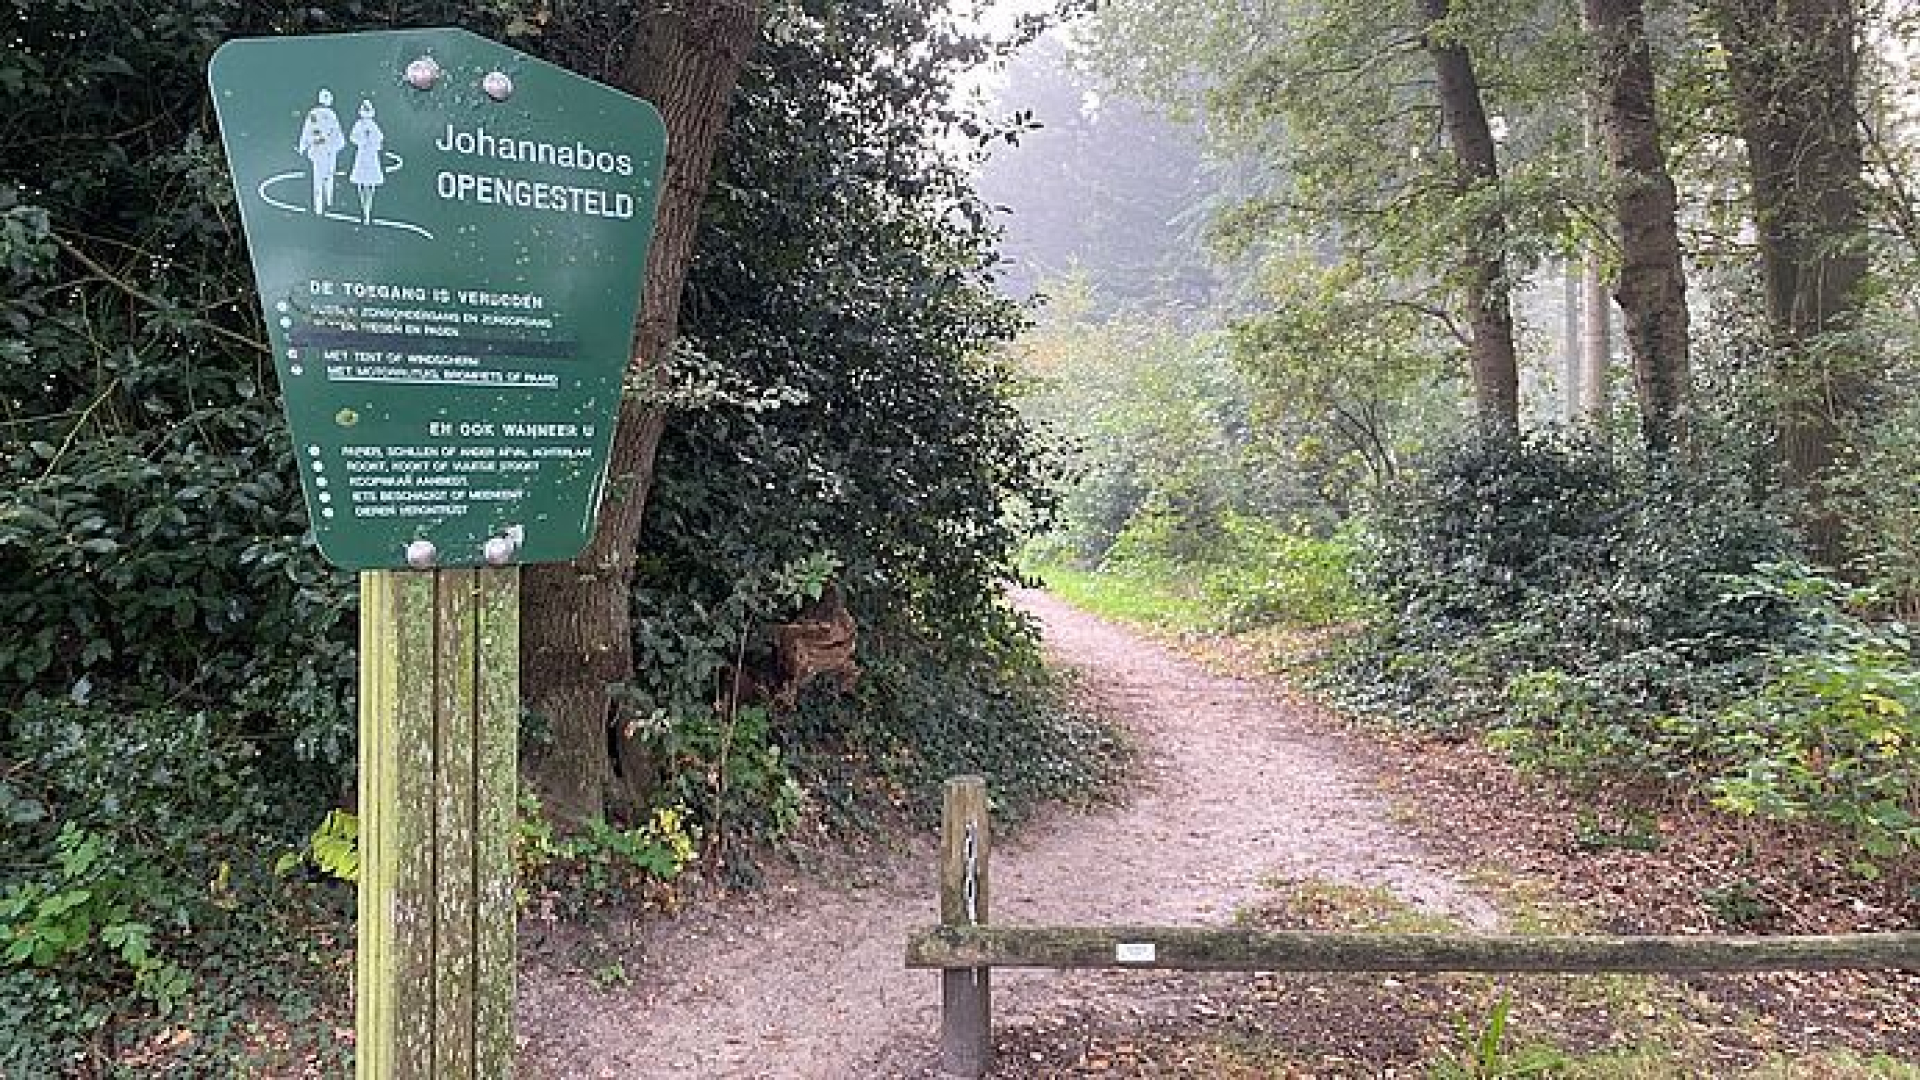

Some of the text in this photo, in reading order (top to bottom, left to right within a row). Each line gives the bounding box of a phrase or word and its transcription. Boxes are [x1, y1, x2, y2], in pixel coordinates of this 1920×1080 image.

[435, 124, 634, 176] Johannabos
[437, 171, 634, 218] OPENGESTELD
[310, 280, 334, 295] DE
[342, 282, 426, 301] TOEGANG
[433, 288, 451, 303] IS
[324, 349, 479, 366] MET TENT OF WINDSCHERM
[327, 365, 354, 376] MET
[505, 371, 523, 381] OF
[429, 421, 595, 438] EN OOK WANNEER U
[386, 446, 440, 457] SCHILLEN
[441, 446, 456, 457] OF
[432, 460, 447, 472] OF
[352, 490, 378, 501] IETS
[449, 490, 468, 501] OF
